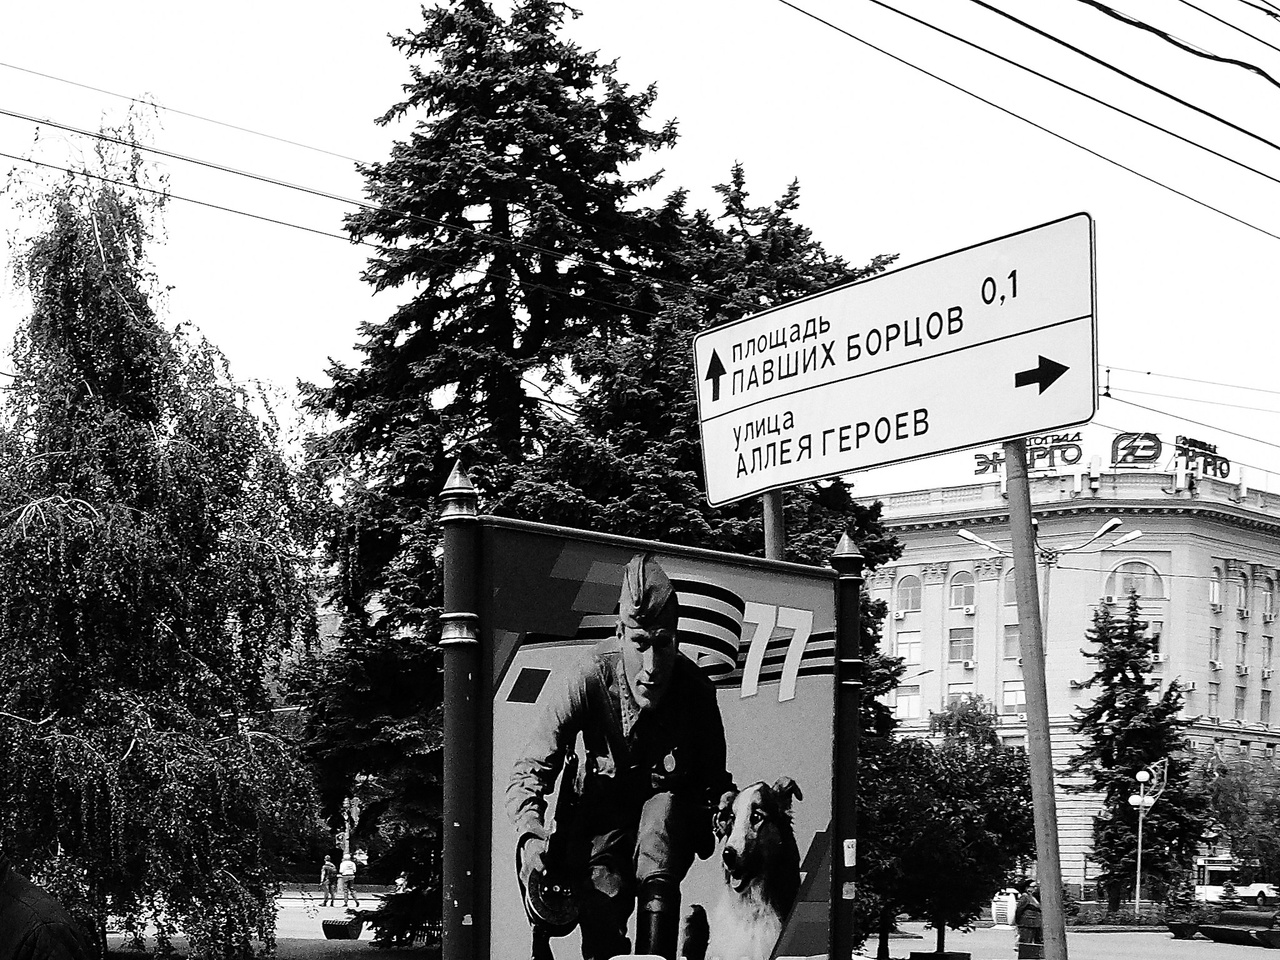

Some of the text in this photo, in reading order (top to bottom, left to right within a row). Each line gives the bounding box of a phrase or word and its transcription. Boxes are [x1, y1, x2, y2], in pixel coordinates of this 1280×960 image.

[981, 269, 1018, 306] 0,1
[732, 314, 831, 362] площадь
[732, 304, 964, 396] ПАВШИХ БОРЦОВ
[733, 410, 795, 452] улица
[736, 407, 930, 479] АЛЛЕЯ ГЕРОЕВ
[974, 444, 1083, 475] ЭНРГО
[742, 602, 814, 702] 77
